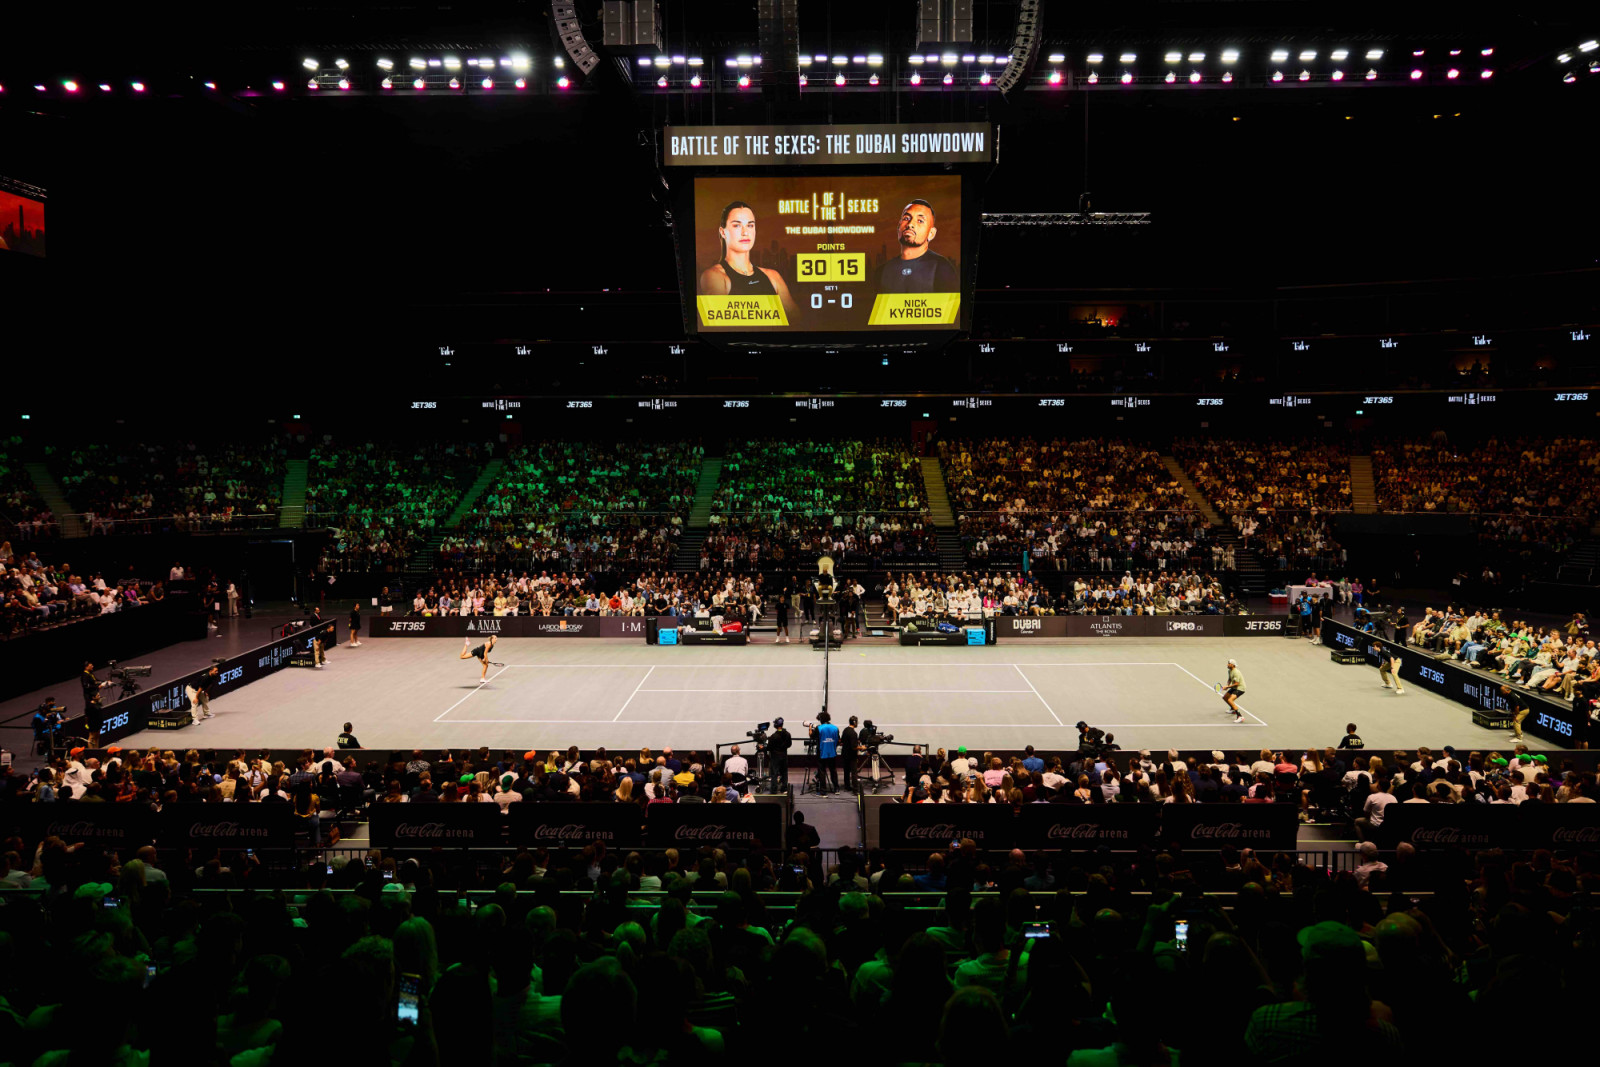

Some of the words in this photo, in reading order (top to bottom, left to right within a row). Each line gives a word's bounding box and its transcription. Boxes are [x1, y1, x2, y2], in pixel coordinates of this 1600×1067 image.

[671, 135, 718, 156] BATTLE
[723, 135, 740, 156] OF
[746, 135, 770, 155] THE
[774, 134, 820, 155] SEXES:
[826, 134, 850, 154] THE
[856, 134, 896, 154] DUBAI
[901, 132, 984, 153] SHOWDOWN
[823, 192, 834, 205] OF
[778, 199, 809, 214] BATTLE
[848, 198, 879, 213] SEXES
[821, 206, 836, 220] THE
[786, 226, 800, 234] THE
[802, 226, 826, 234] DUBAI
[827, 226, 875, 234] SHOWDOWN
[801, 260, 826, 276] 30
[837, 259, 858, 275] 15
[727, 301, 760, 310] ARYNA
[811, 294, 822, 309] 0
[841, 293, 852, 308] 0
[904, 299, 927, 307] NICK
[708, 309, 780, 320] SABALENKA
[889, 307, 942, 318] KYRGIOS
[390, 622, 425, 631] JET365
[478, 620, 501, 630] ANAX
[1013, 619, 1041, 630] DUBAI
[1245, 621, 1281, 630] JET365
[218, 666, 243, 685] JET365
[1419, 665, 1444, 684] JET365
[1464, 683, 1478, 698] BATTLE
[1485, 686, 1490, 696] OF
[100, 711, 128, 734] ET365
[1537, 712, 1572, 736] JET365
[240, 828, 268, 837] arena
[446, 829, 474, 838] arena
[585, 831, 613, 840] arena
[726, 831, 754, 840] arena
[956, 830, 984, 839] arena
[1100, 830, 1128, 839] arena
[1242, 829, 1270, 838] arena
[1461, 834, 1488, 843] arena
